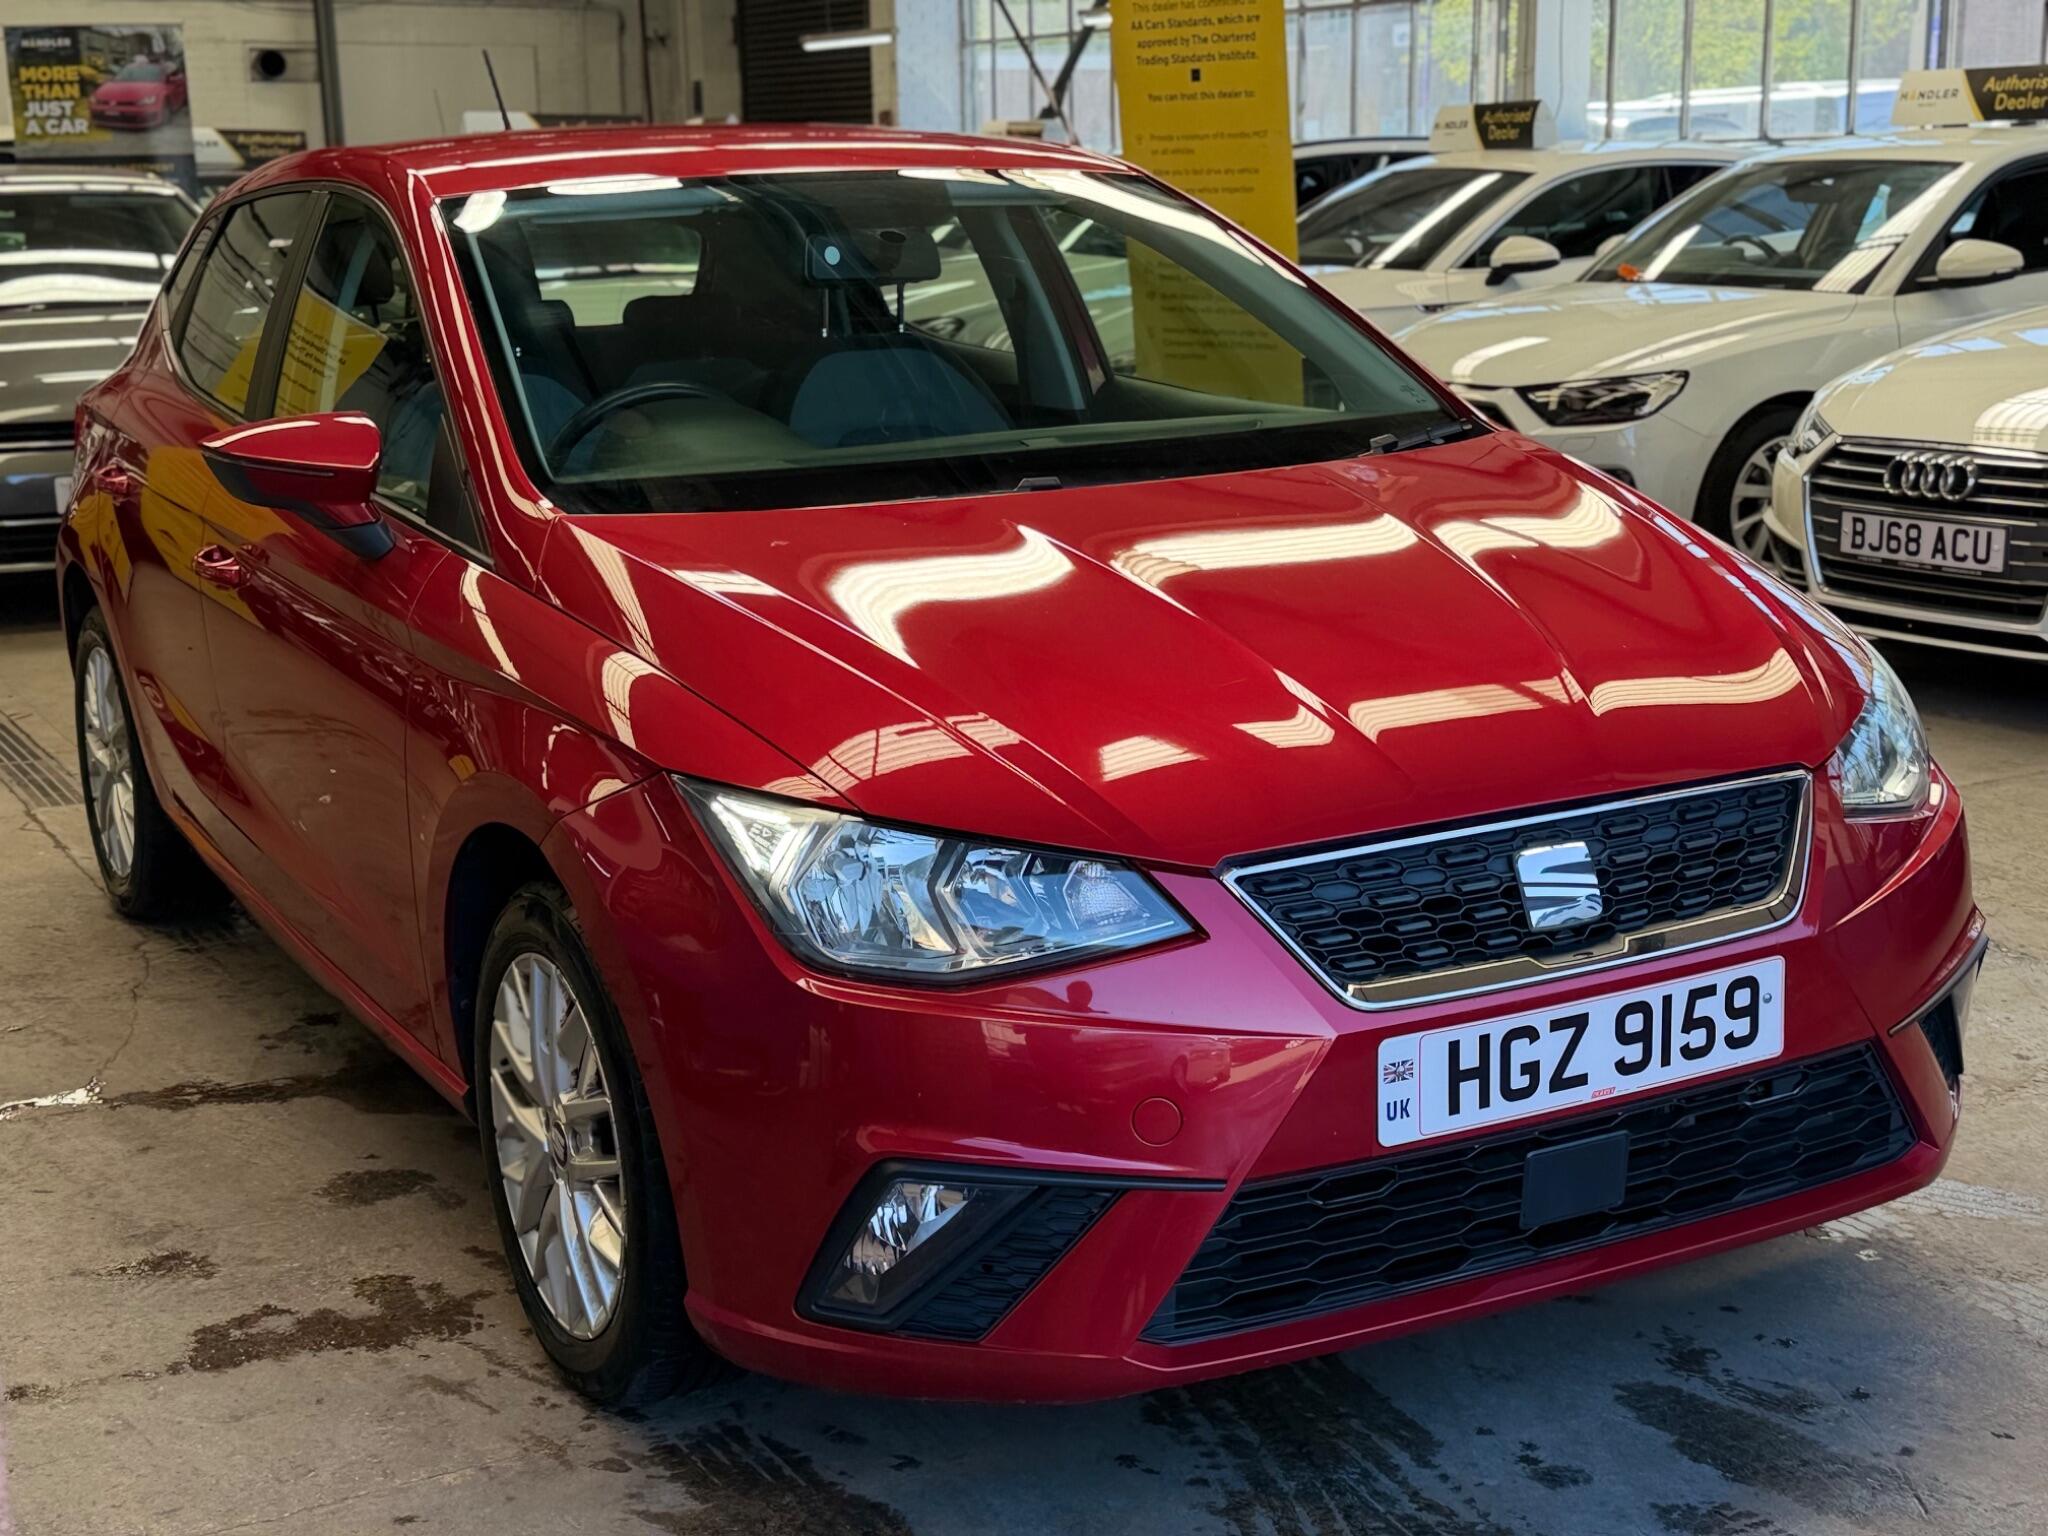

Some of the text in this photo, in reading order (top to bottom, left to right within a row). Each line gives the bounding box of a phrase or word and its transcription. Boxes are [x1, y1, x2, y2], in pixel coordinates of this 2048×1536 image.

[1131, 13, 1260, 30] AA Cars Standards, which are
[1137, 32, 1256, 49] approved by The Chartered
[1136, 54, 1169, 66] Trading
[1171, 53, 1216, 64] Standards
[19, 65, 80, 82] MORE
[20, 83, 81, 99] THAN
[1200, 91, 1215, 100] this
[1217, 89, 1242, 100] dealer
[23, 101, 75, 117] JUST
[1994, 91, 2048, 111] Dealer
[1481, 108, 1533, 123] Authorised
[25, 118, 90, 136] A CAR
[1488, 124, 1521, 141] Dealer
[1851, 516, 1992, 565] BJ68 ACU
[1447, 974, 1761, 1117] HGZ 9159
[1386, 1097, 1411, 1122] UK
